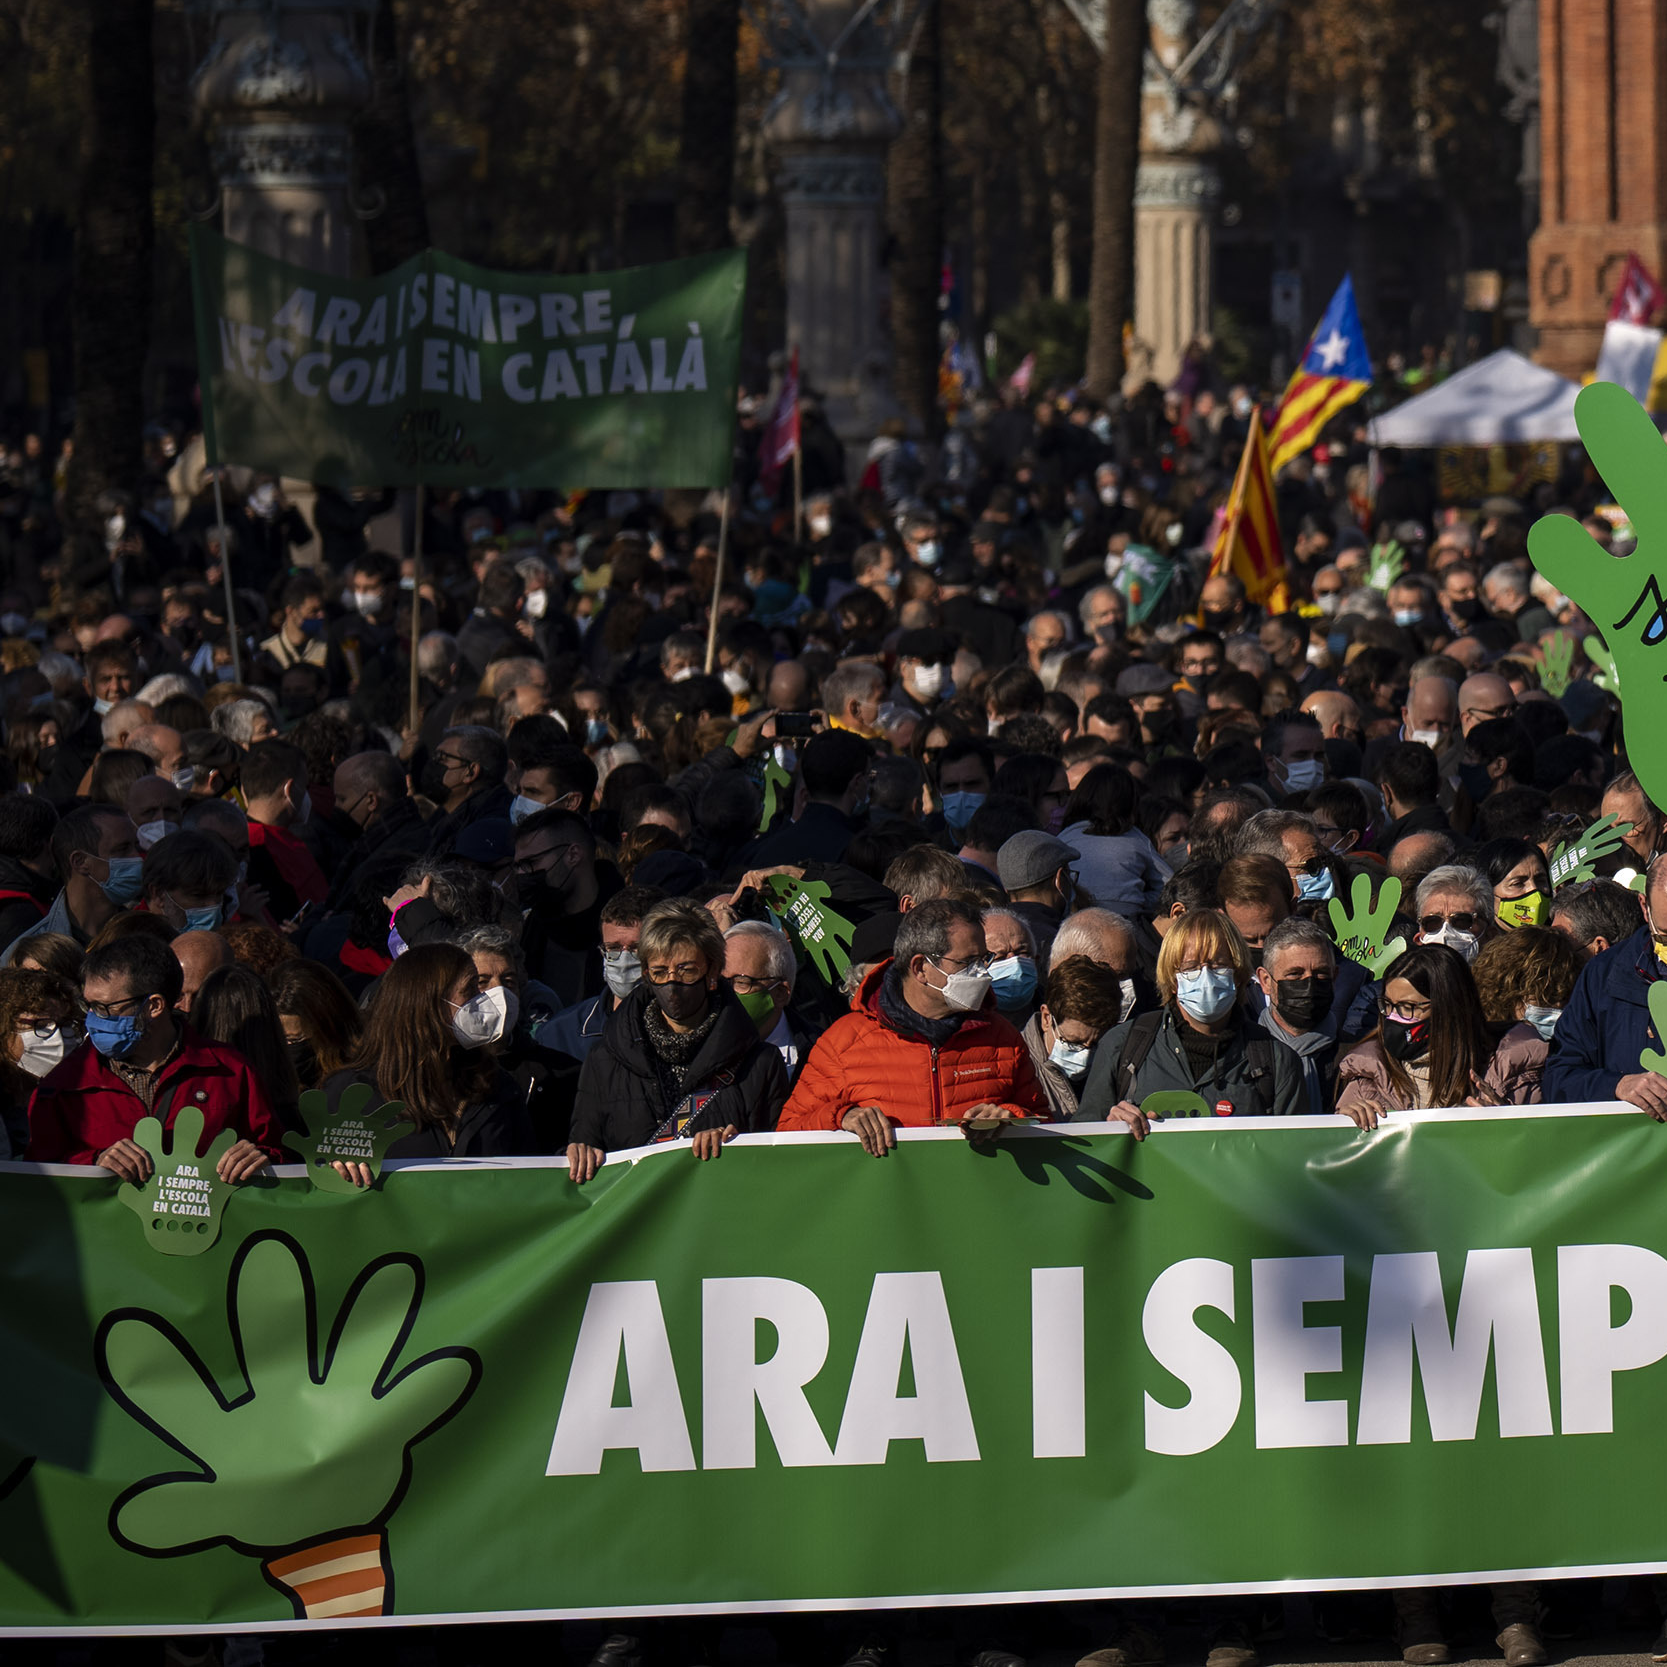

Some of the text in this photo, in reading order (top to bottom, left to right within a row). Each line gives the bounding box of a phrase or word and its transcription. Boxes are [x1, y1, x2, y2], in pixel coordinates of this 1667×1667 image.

[272, 287, 387, 346] ARA
[422, 338, 482, 402] EN
[501, 321, 708, 403] CATALÀ
[175, 1164, 199, 1178] ARA
[165, 1177, 213, 1194] SEMPRE,
[158, 1189, 208, 1204] L'ESCOLA
[152, 1201, 211, 1217] EN CATALÀ
[546, 1271, 981, 1477] ARA
[1031, 1267, 1086, 1459] I
